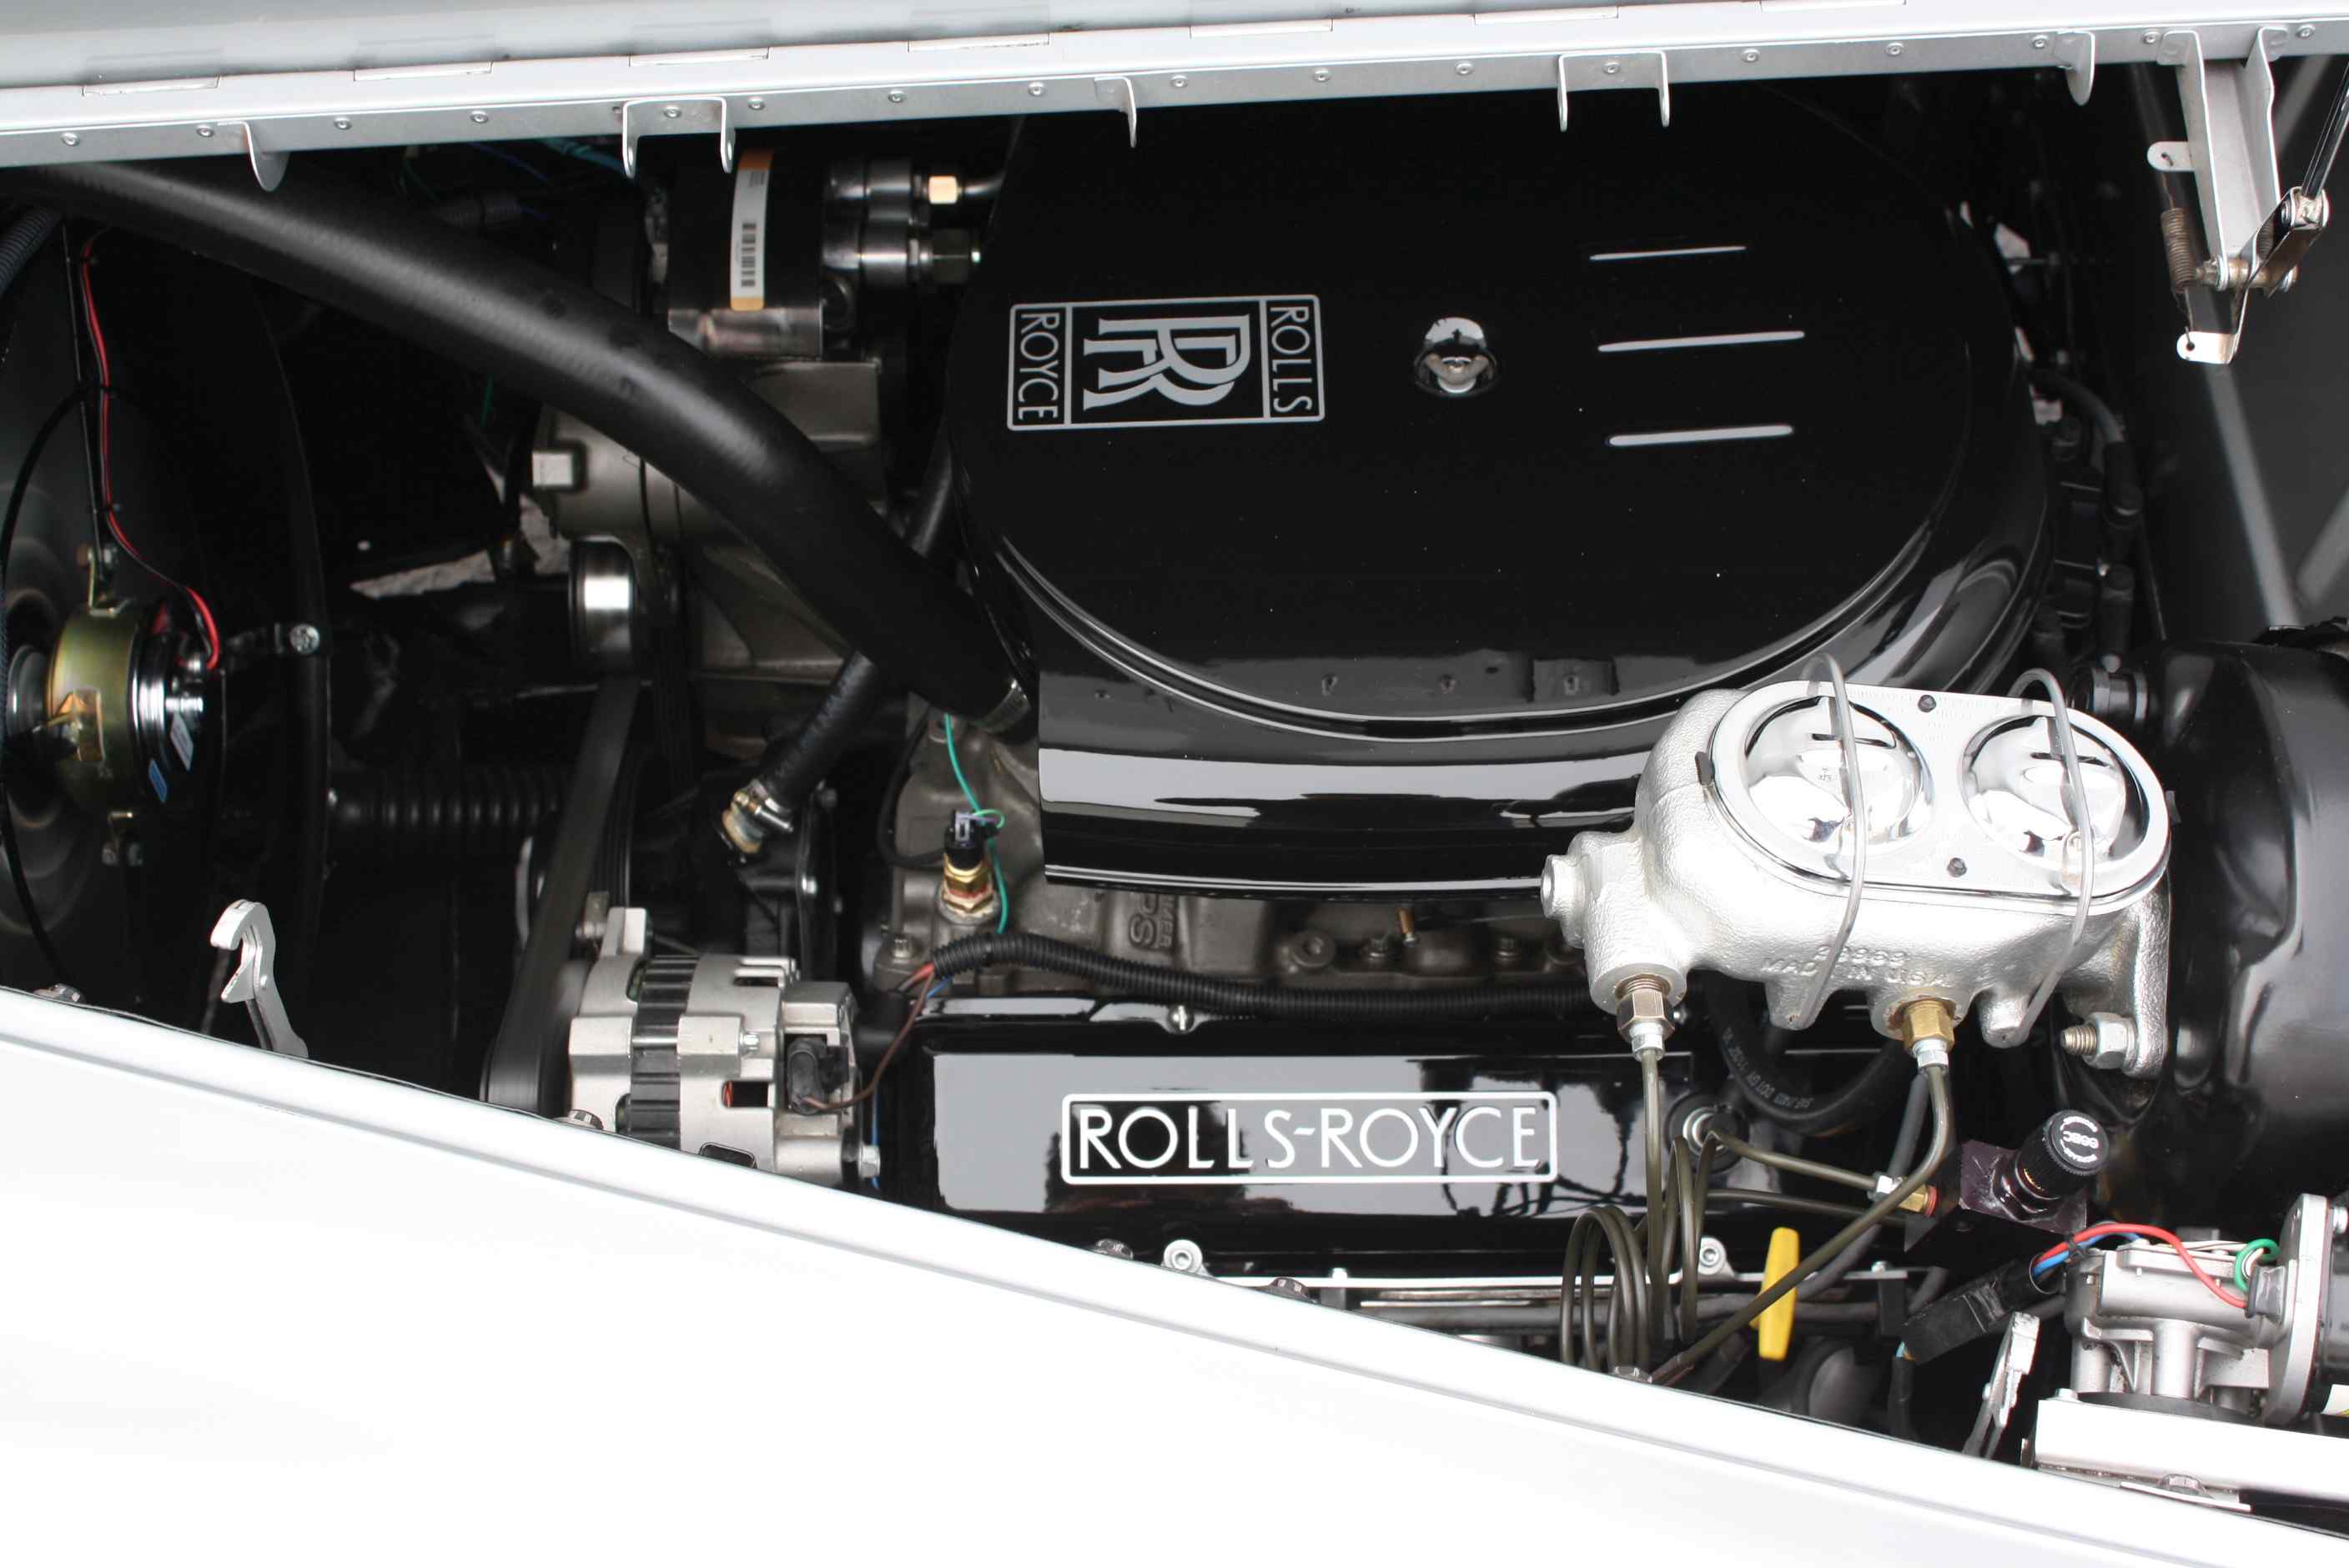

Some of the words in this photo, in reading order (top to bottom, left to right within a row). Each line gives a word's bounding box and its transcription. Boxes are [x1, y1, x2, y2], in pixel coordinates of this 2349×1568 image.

[1018, 313, 1060, 420] ROYCE
[1270, 306, 1313, 412] ROLLS
[1079, 1105, 1540, 1169] ROLLS-ROYCE
